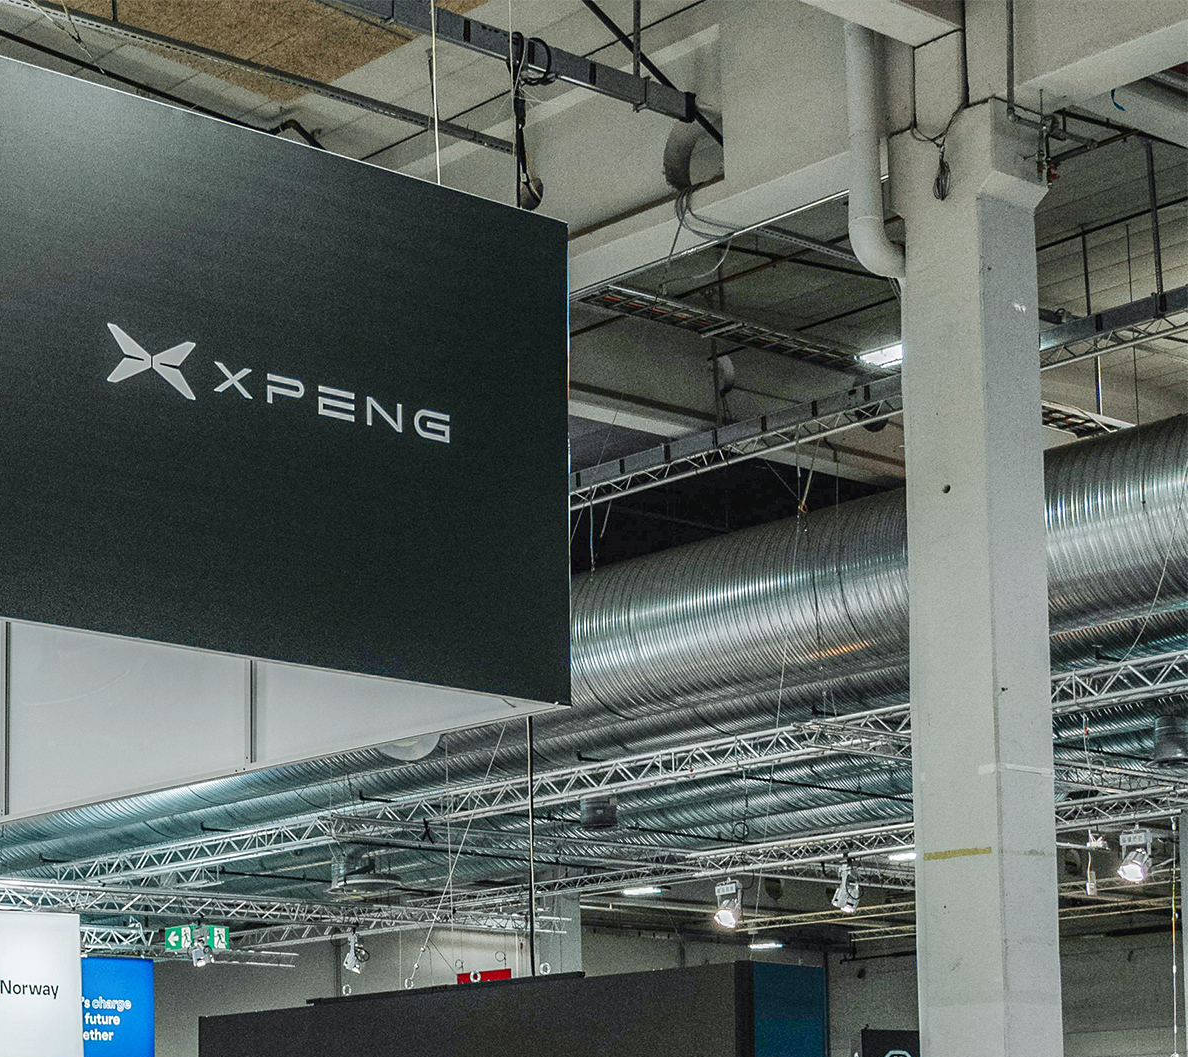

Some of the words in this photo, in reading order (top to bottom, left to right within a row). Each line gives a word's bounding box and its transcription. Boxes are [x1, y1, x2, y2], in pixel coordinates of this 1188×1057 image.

[213, 361, 451, 444] XPENG
[0, 979, 60, 1000] Norway
[92, 996, 132, 1012] charge
[84, 1012, 121, 1025] future
